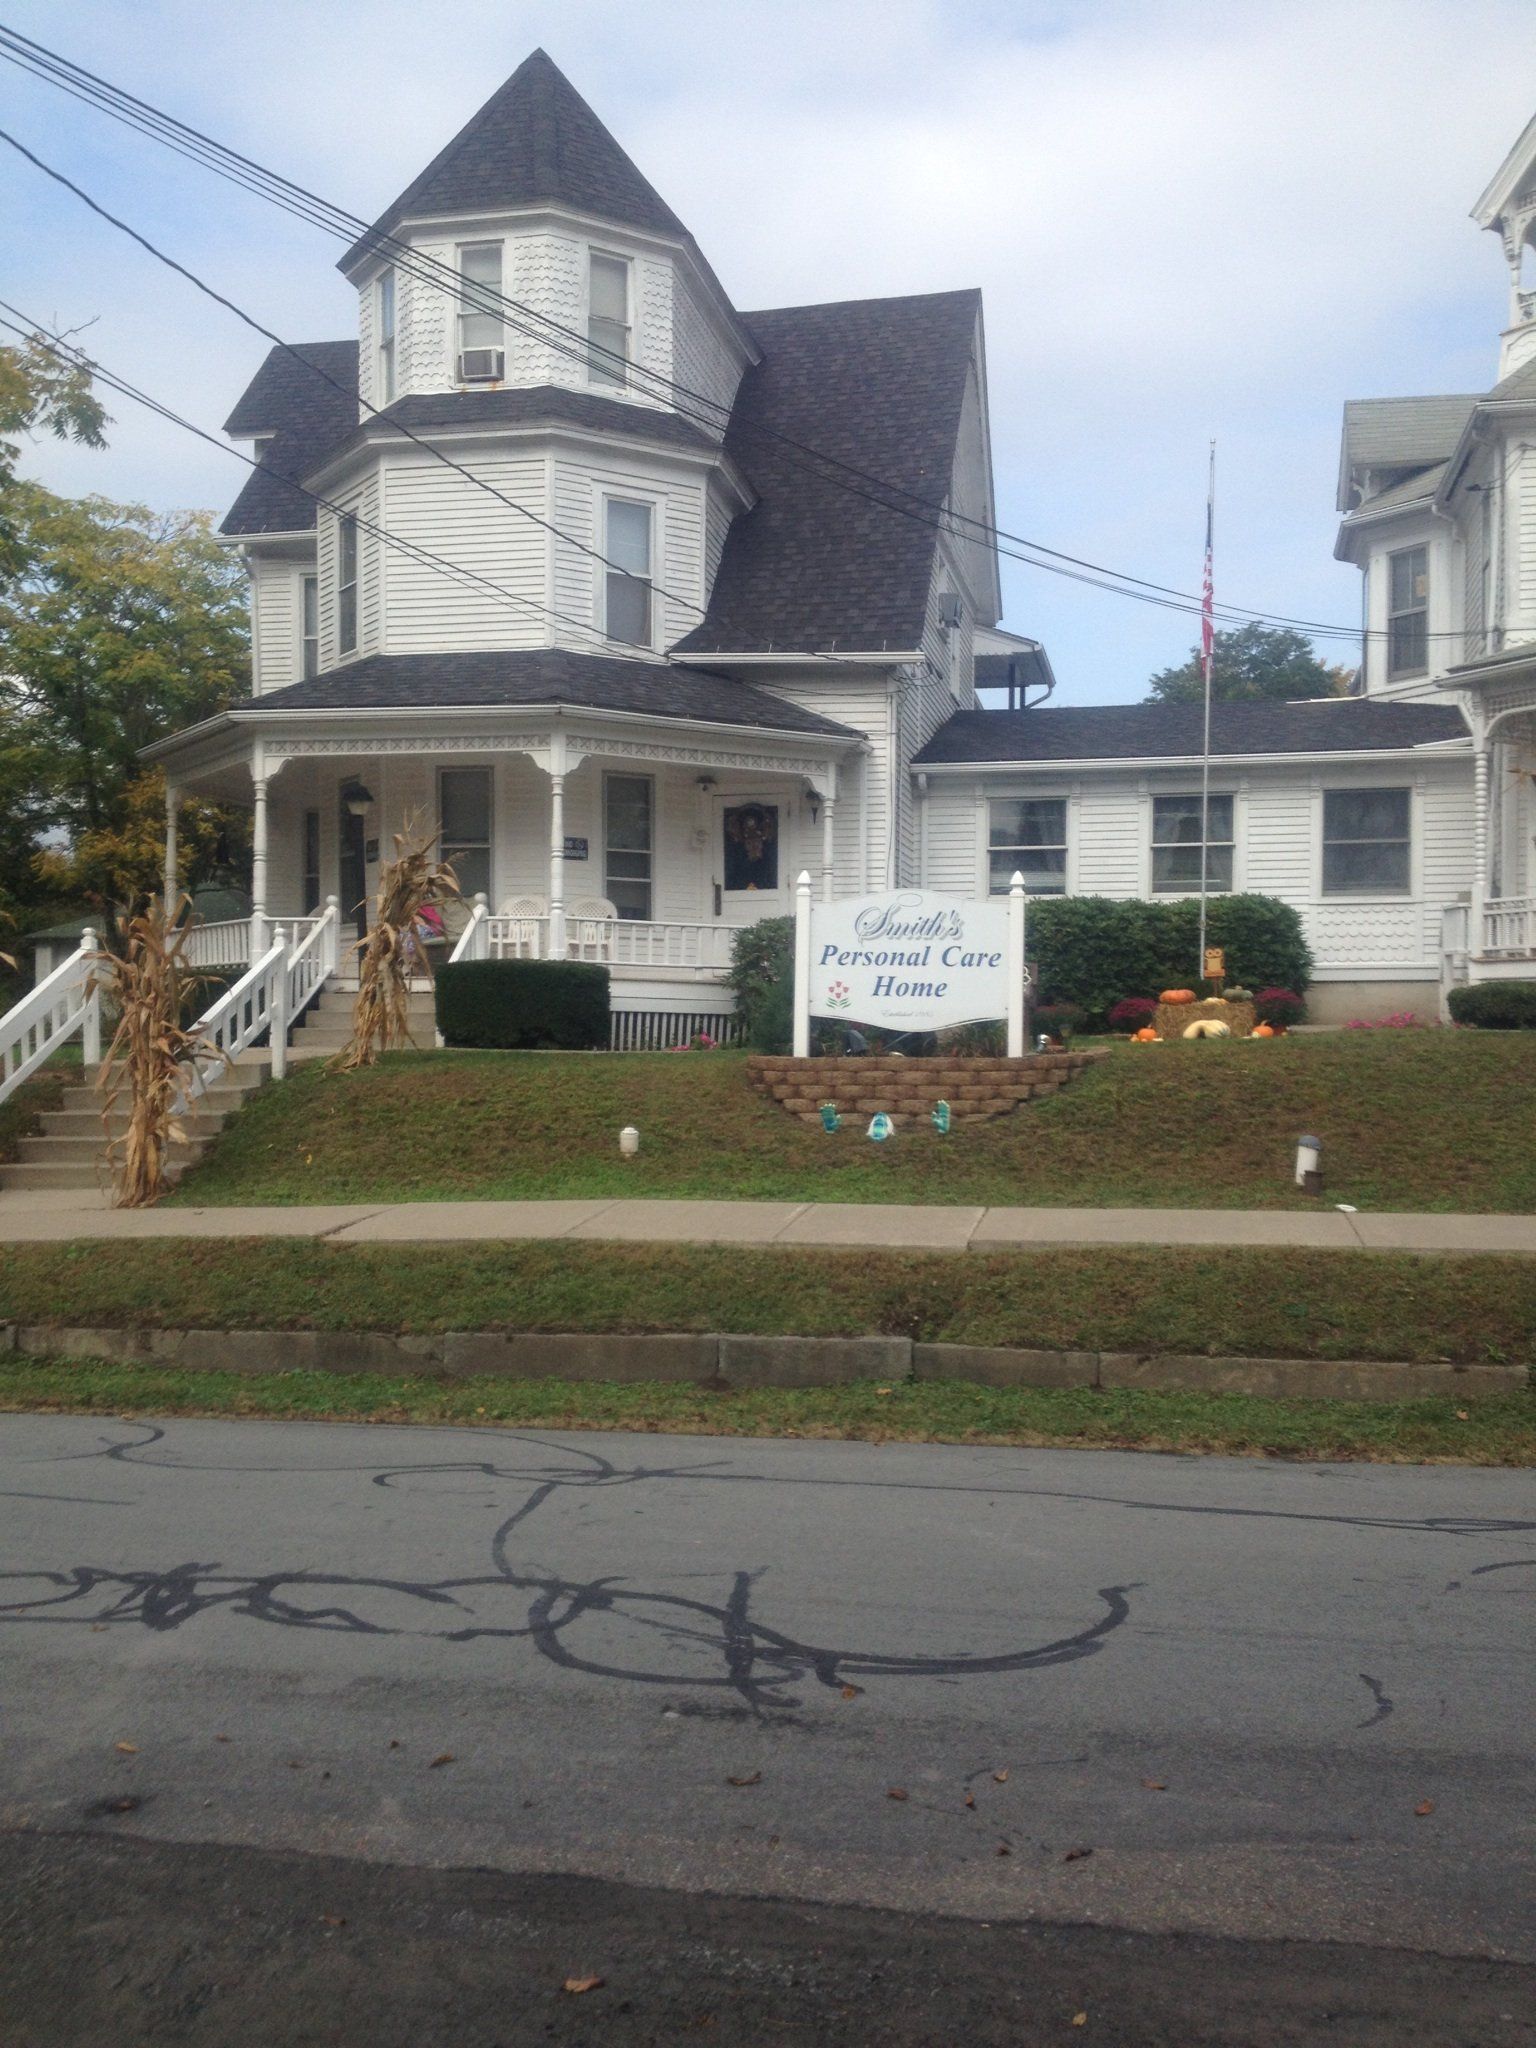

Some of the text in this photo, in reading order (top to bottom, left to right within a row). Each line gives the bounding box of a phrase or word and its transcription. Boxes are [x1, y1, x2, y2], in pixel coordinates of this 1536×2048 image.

[854, 893, 965, 945] Smith's
[818, 944, 1002, 968] Personal Care
[871, 975, 948, 998] Home
